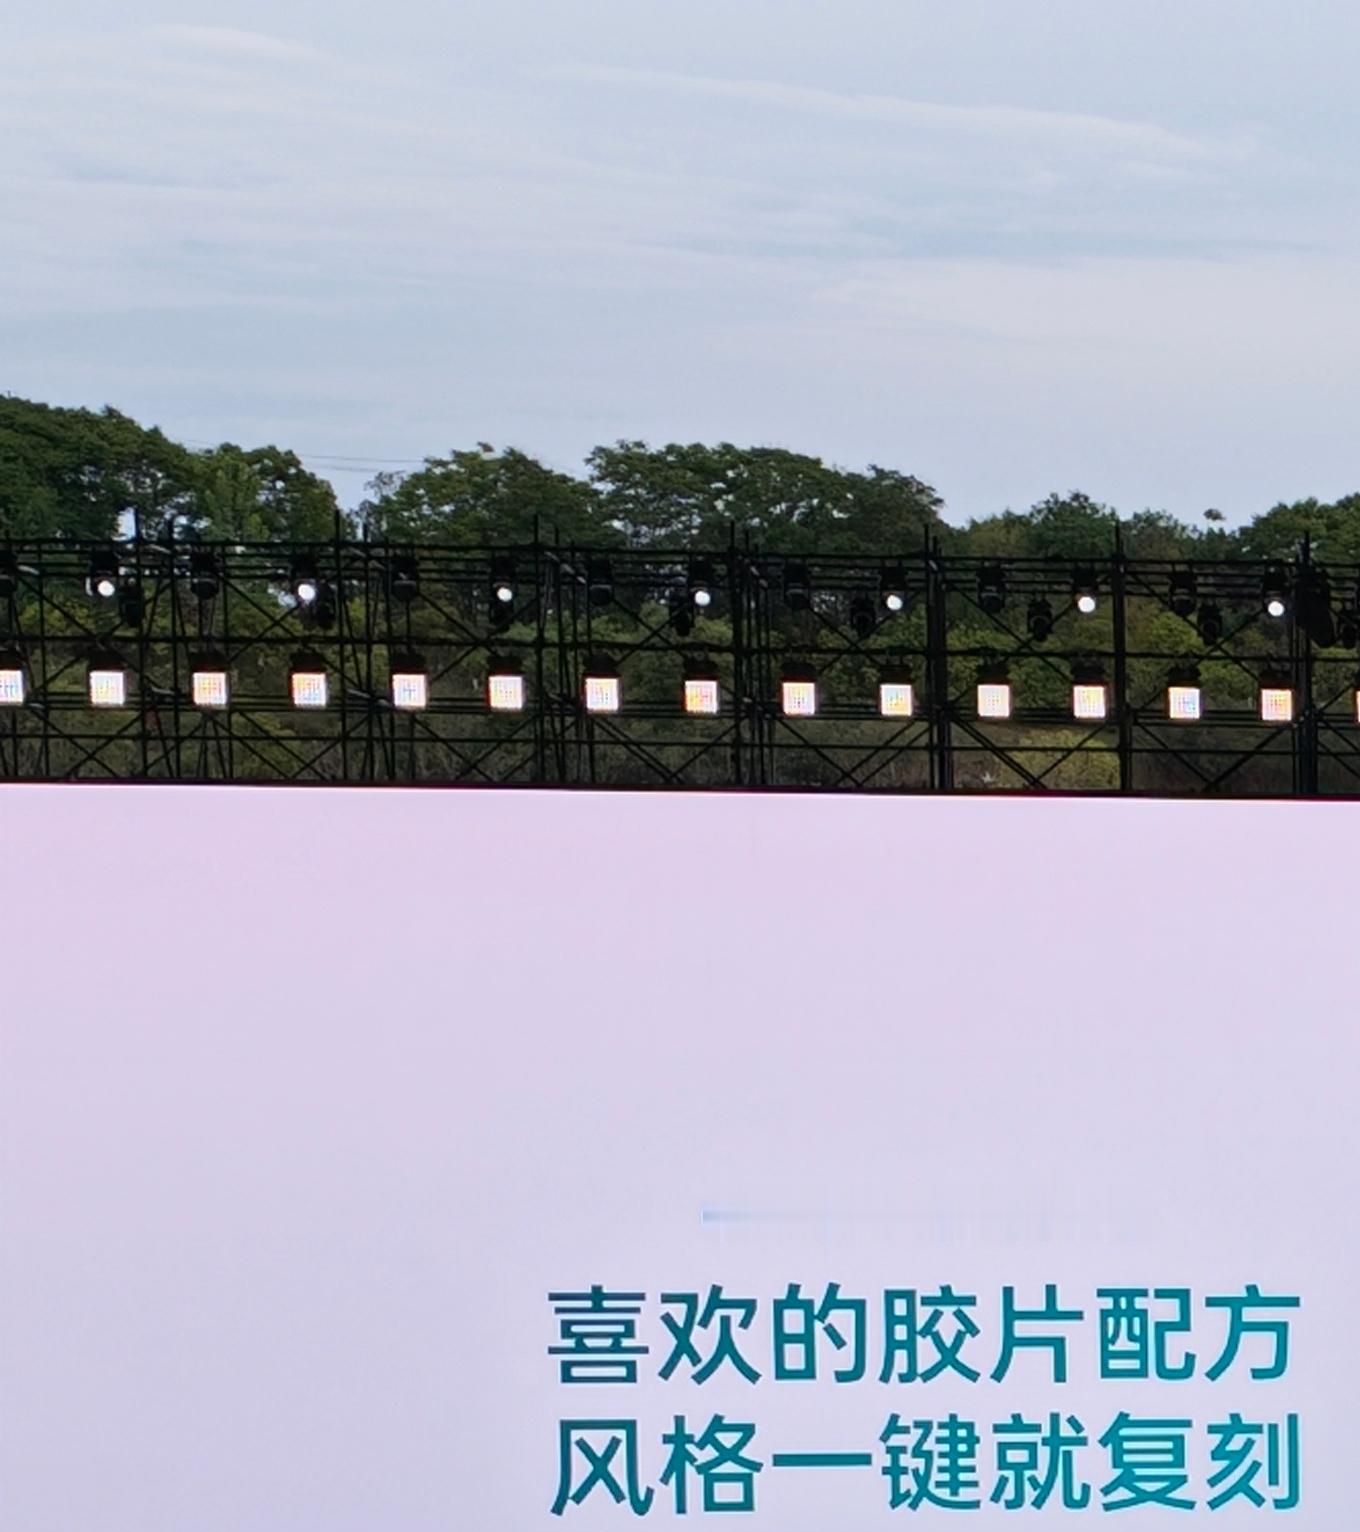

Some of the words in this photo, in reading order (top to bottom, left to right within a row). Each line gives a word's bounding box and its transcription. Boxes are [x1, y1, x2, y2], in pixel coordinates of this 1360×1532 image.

[547, 1282, 1301, 1386] 喜欢的胶片配方
[550, 1411, 1301, 1517] 风格一键就复刻
